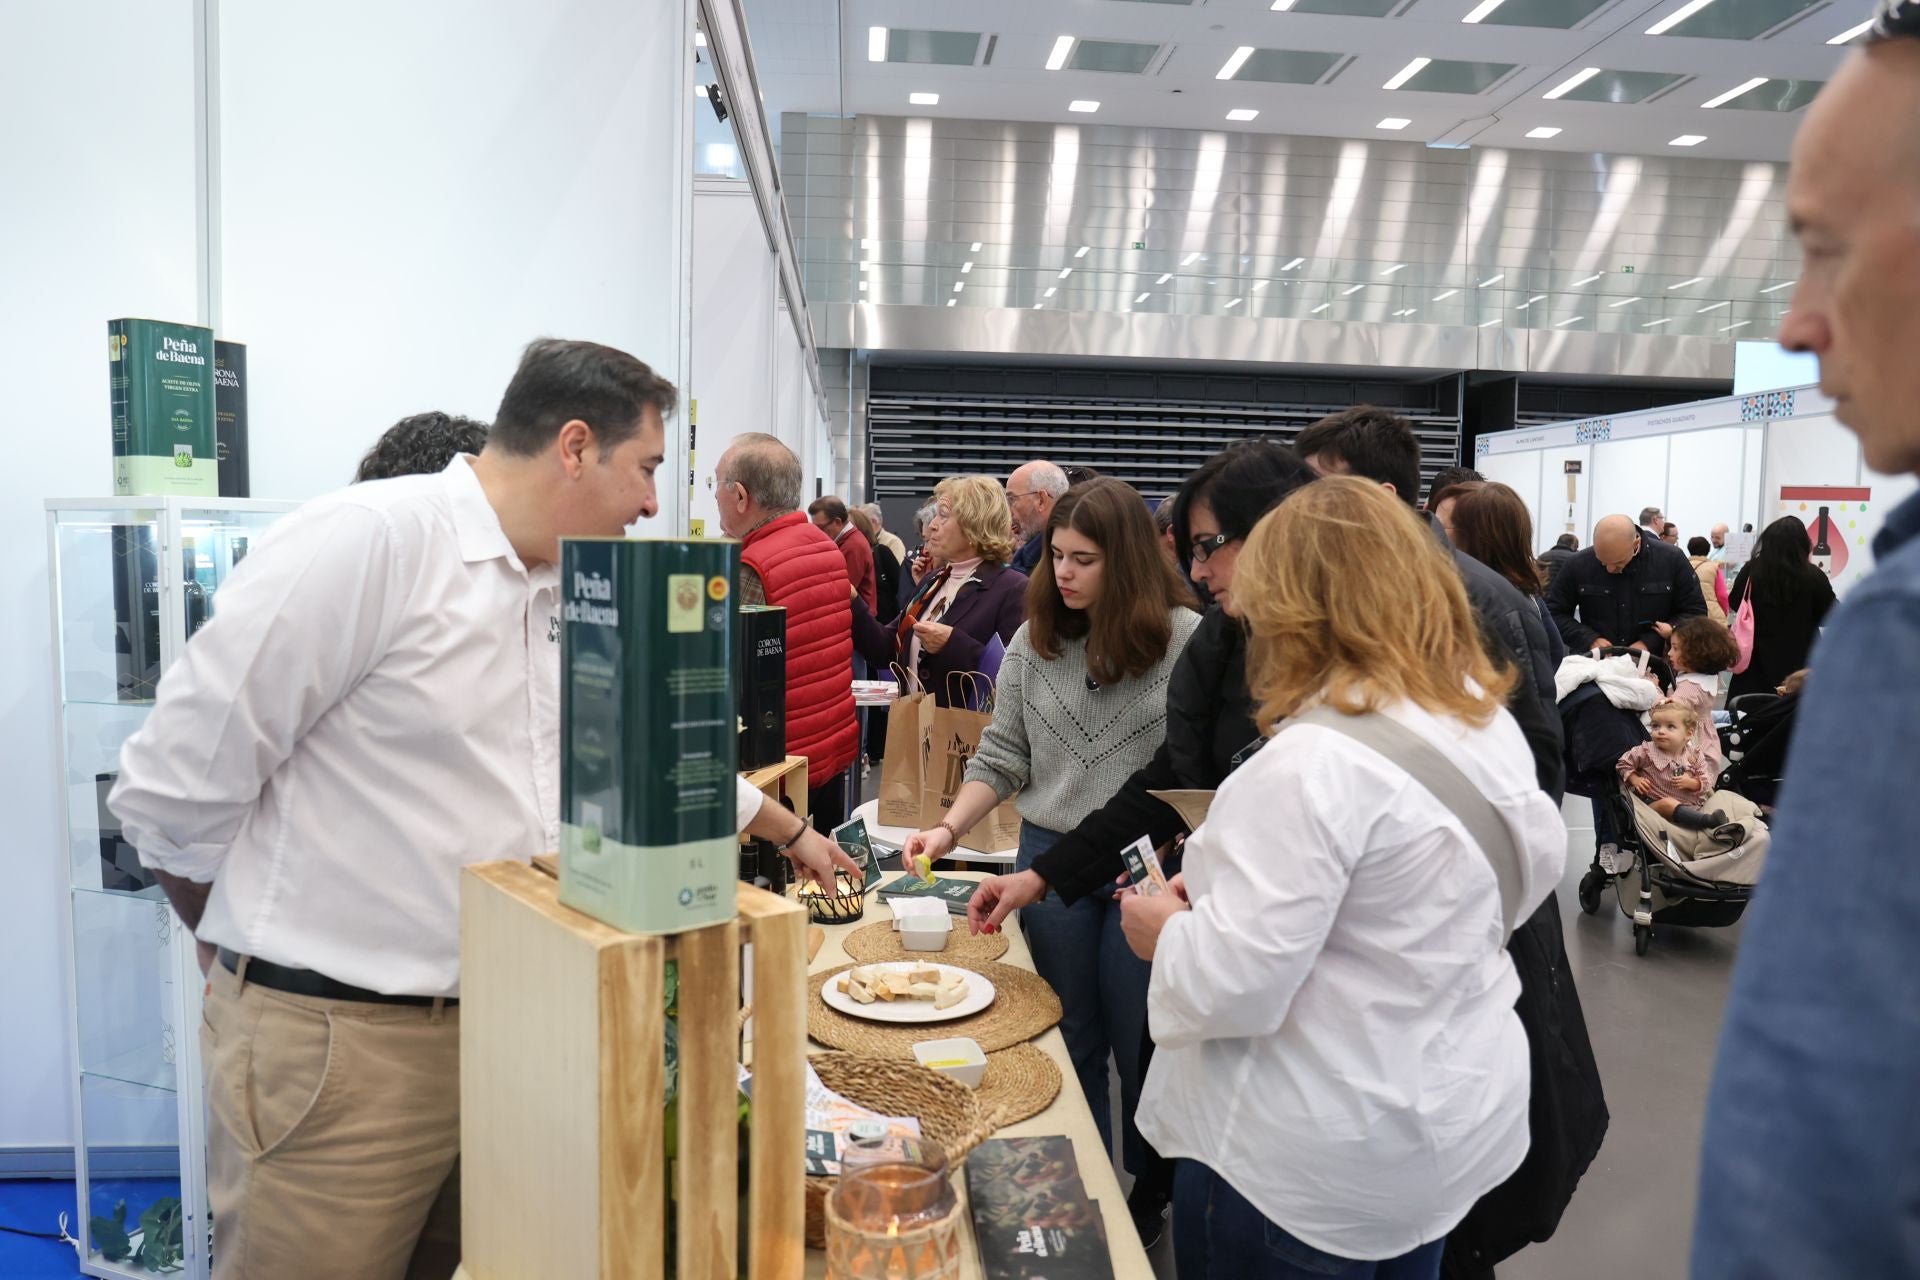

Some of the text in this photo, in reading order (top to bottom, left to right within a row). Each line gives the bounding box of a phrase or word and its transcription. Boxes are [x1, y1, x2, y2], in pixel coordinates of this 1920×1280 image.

[163, 336, 197, 353] Peña
[156, 350, 205, 365] de Baena
[573, 570, 612, 601] Peña
[757, 638, 781, 648] CORONA
[756, 646, 782, 657] DE BAENA
